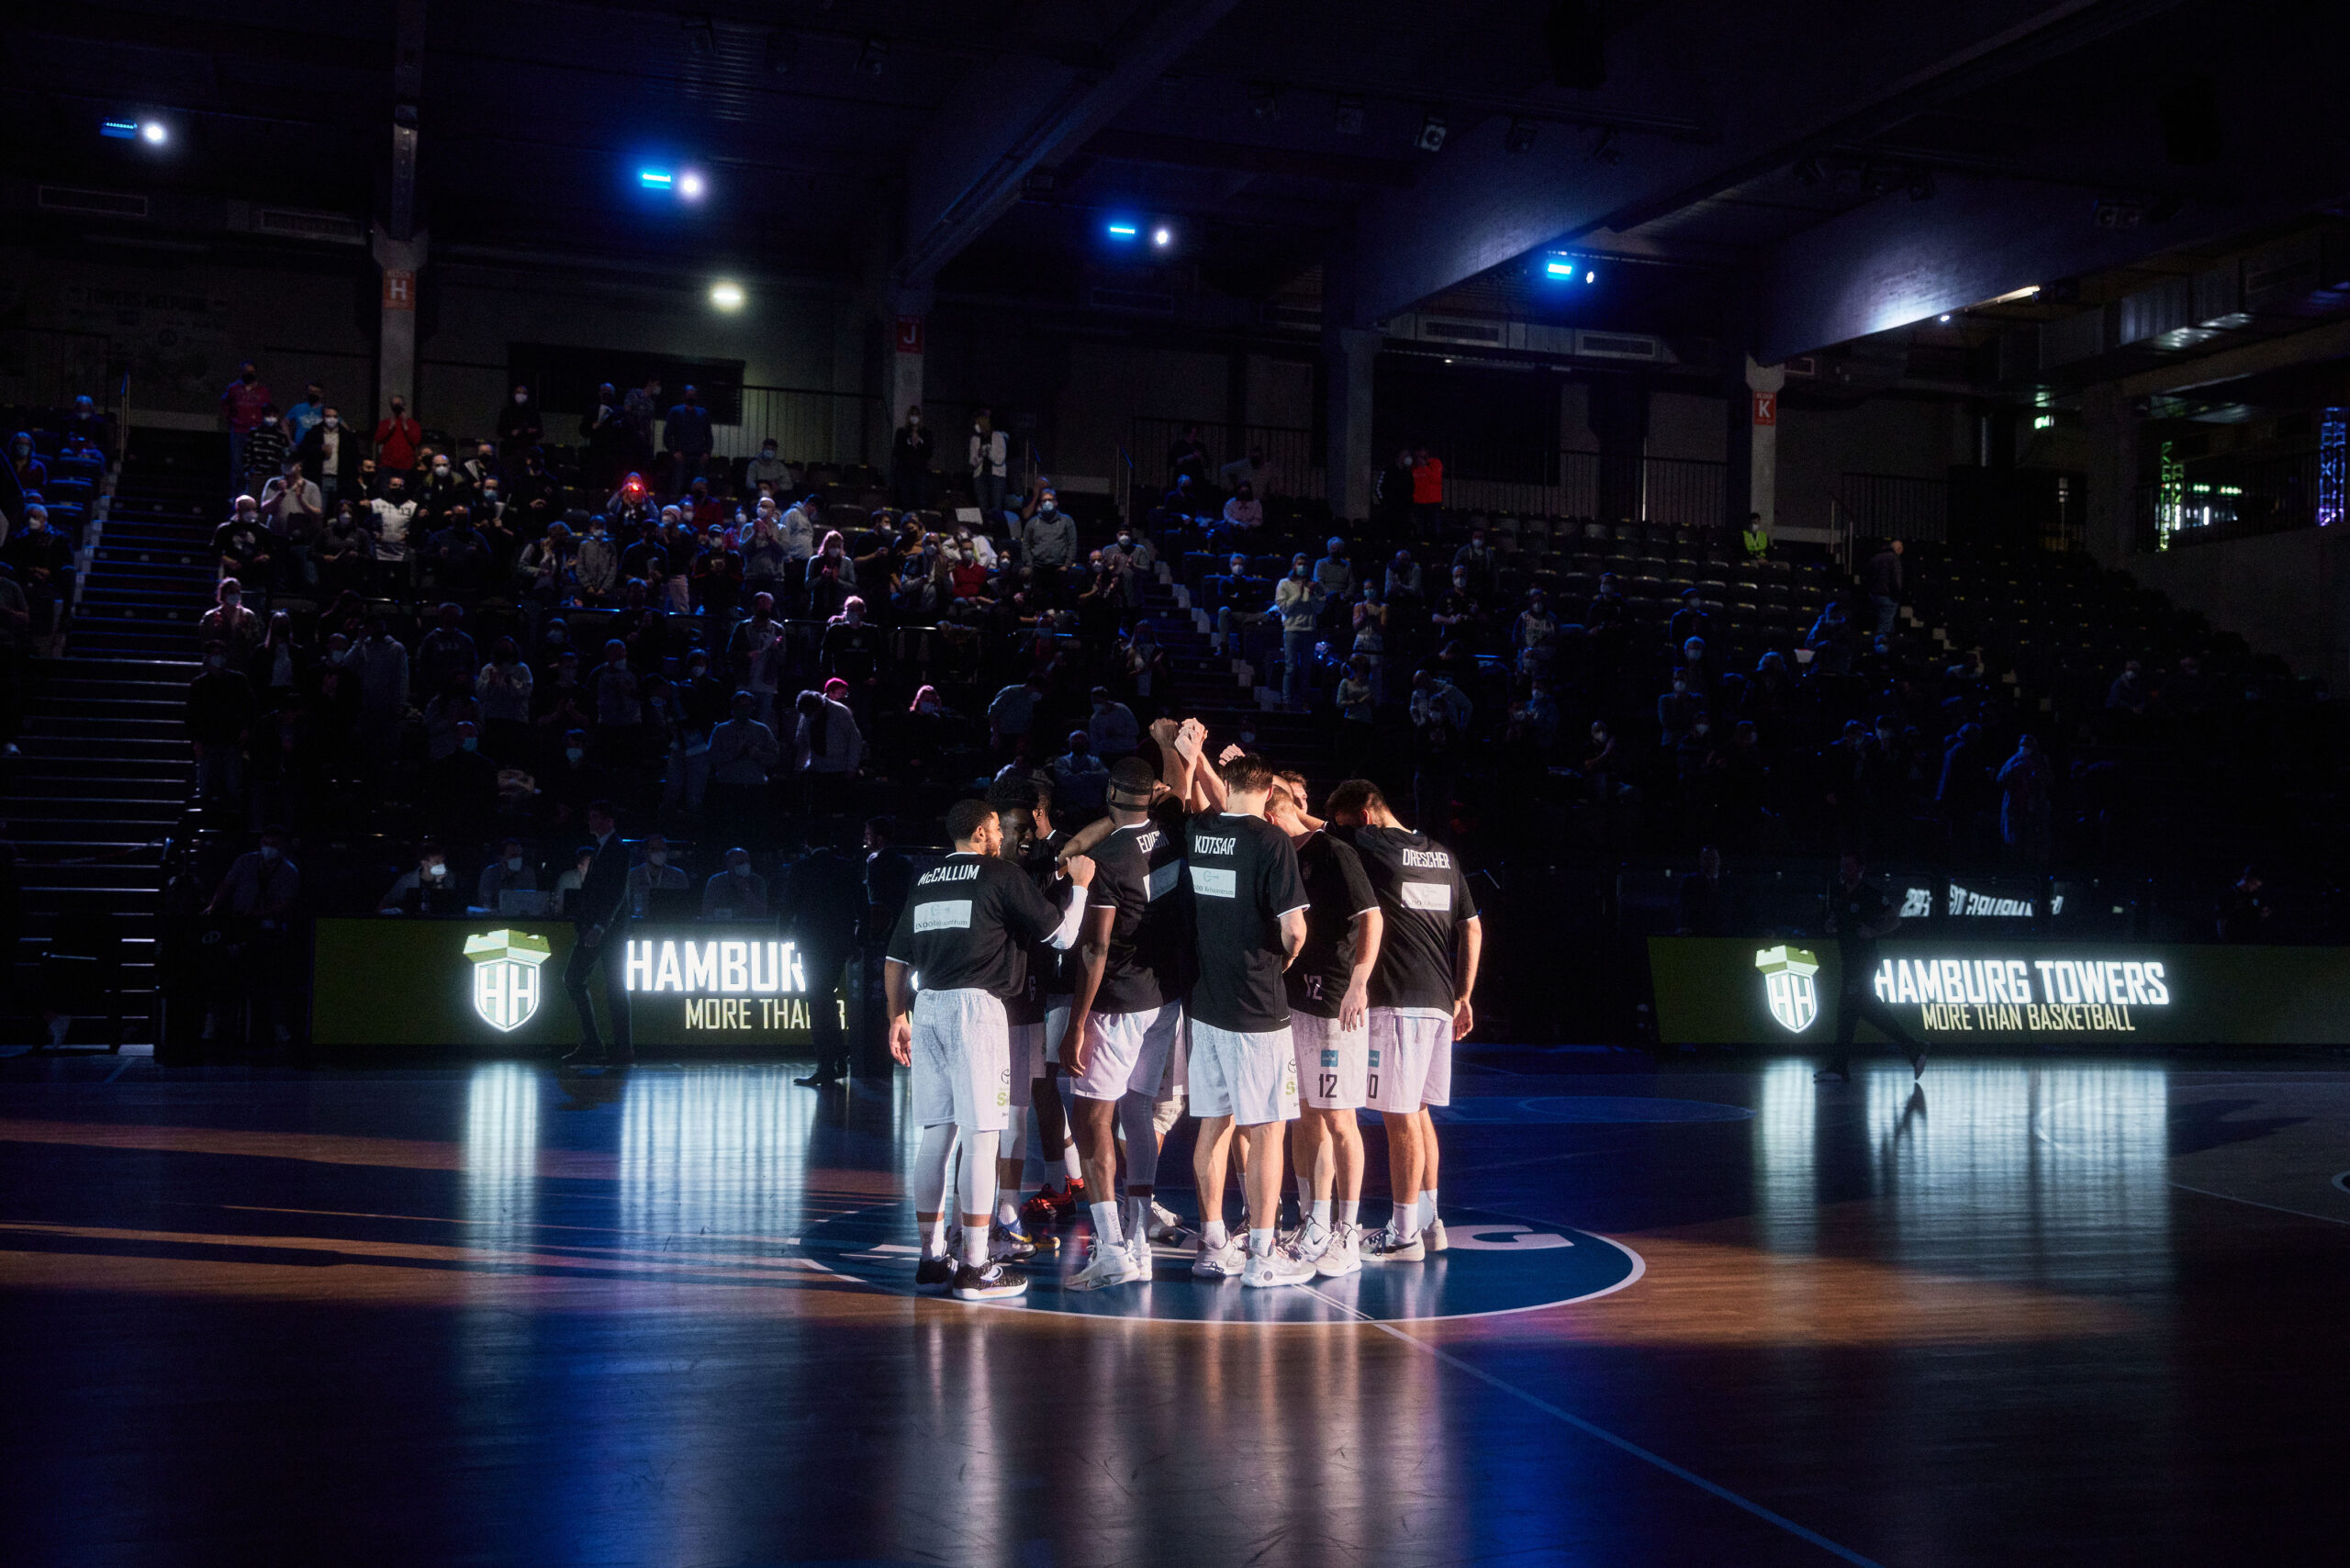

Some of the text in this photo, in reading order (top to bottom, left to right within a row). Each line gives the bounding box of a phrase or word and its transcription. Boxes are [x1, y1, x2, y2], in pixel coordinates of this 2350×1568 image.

[390, 278, 407, 300] H
[903, 324, 916, 344] J
[1759, 399, 1771, 419] K
[1194, 834, 1237, 856] KOTSAR
[1402, 847, 1451, 869] DRESCHER
[917, 864, 980, 887] McCALLUM
[626, 939, 806, 991] HAMBUR
[1874, 958, 2170, 1005] HAMBURG TOWERS
[685, 998, 752, 1030] MORE
[1921, 1002, 2136, 1032] MORE THAN BASKETBALL
[1318, 1073, 1338, 1098] 12
[1367, 1073, 1378, 1099] 0
